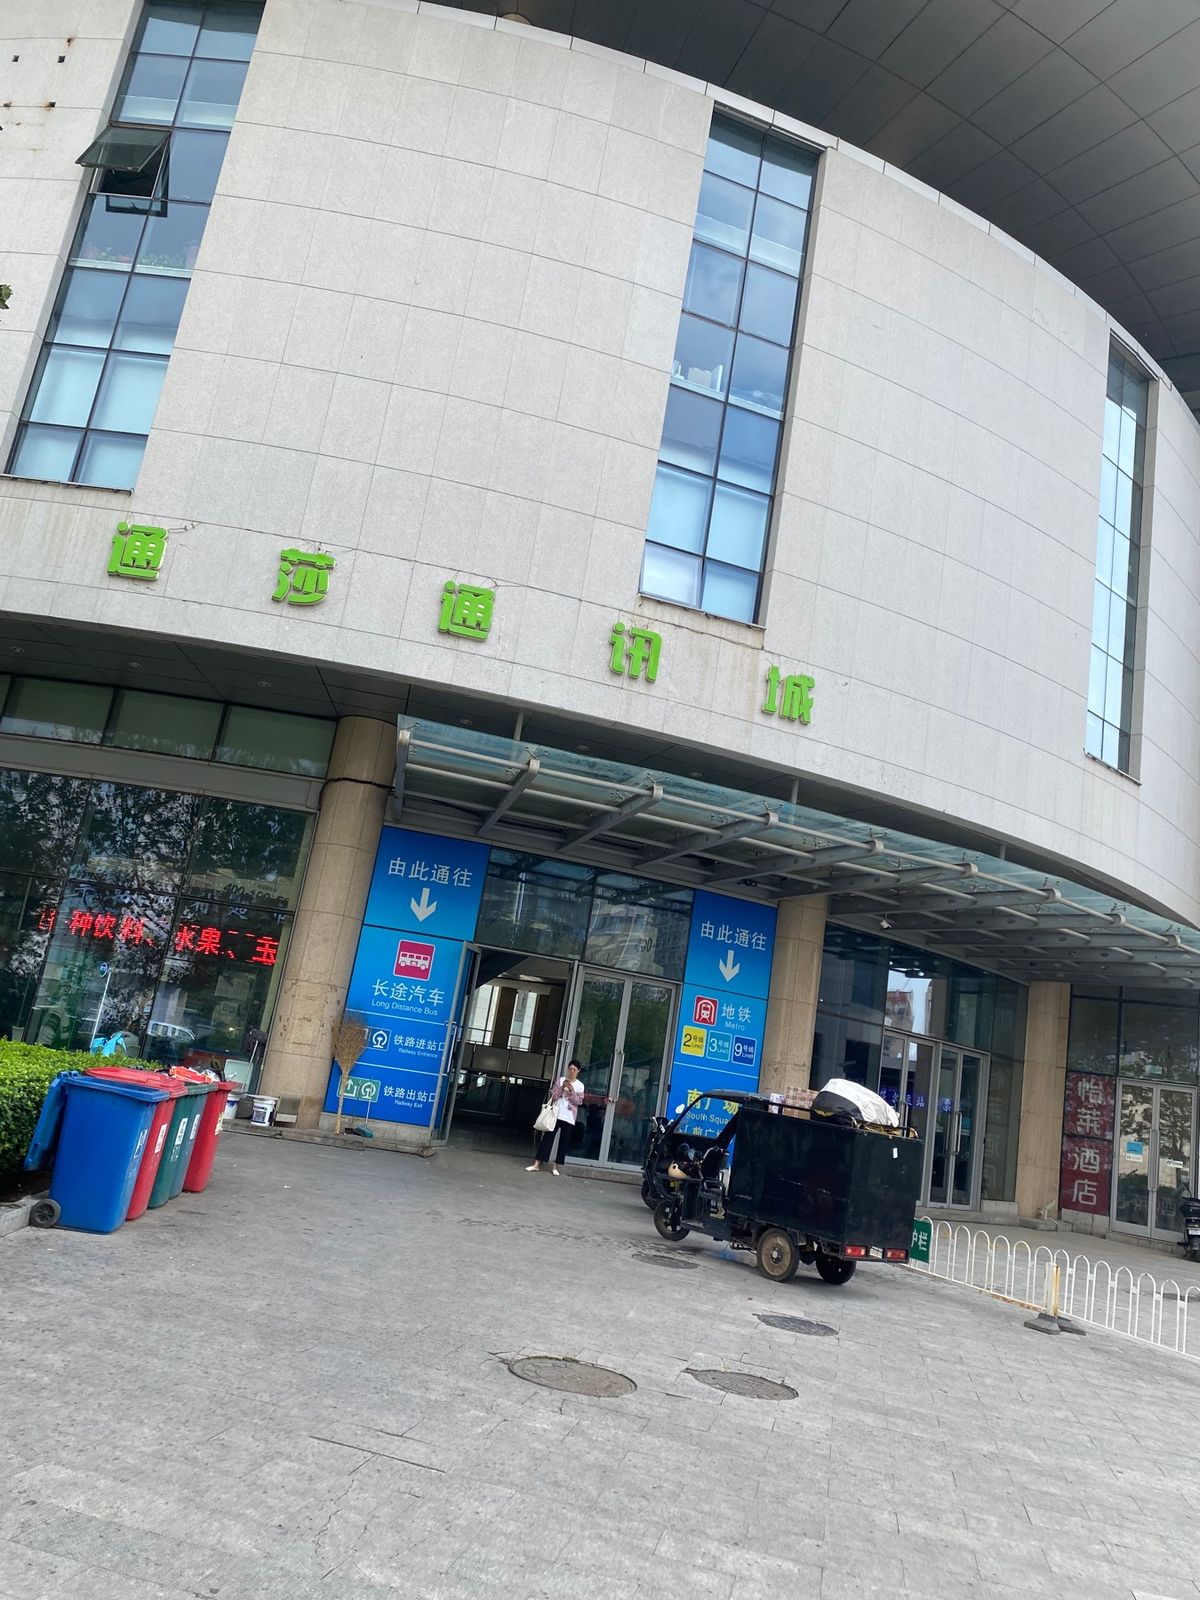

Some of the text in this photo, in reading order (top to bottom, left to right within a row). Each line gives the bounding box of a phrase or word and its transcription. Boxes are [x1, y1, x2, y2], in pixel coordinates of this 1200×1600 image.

[388, 857, 472, 888] 由此通往
[700, 921, 767, 951] 由此通往
[372, 979, 445, 1007] 长途汽车
[372, 999, 438, 1016] Long Distance Bus
[721, 1003, 752, 1023] 地铁
[725, 1021, 746, 1031] Metro
[394, 1034, 445, 1052] 铁路进站口
[399, 1047, 438, 1058] Railway Entrance
[384, 1085, 437, 1103] 铁路出站口
[395, 1099, 413, 1109] Railway
[686, 1111, 730, 1125] South Squa
[1072, 1078, 1104, 1206] 怡莱酒店
